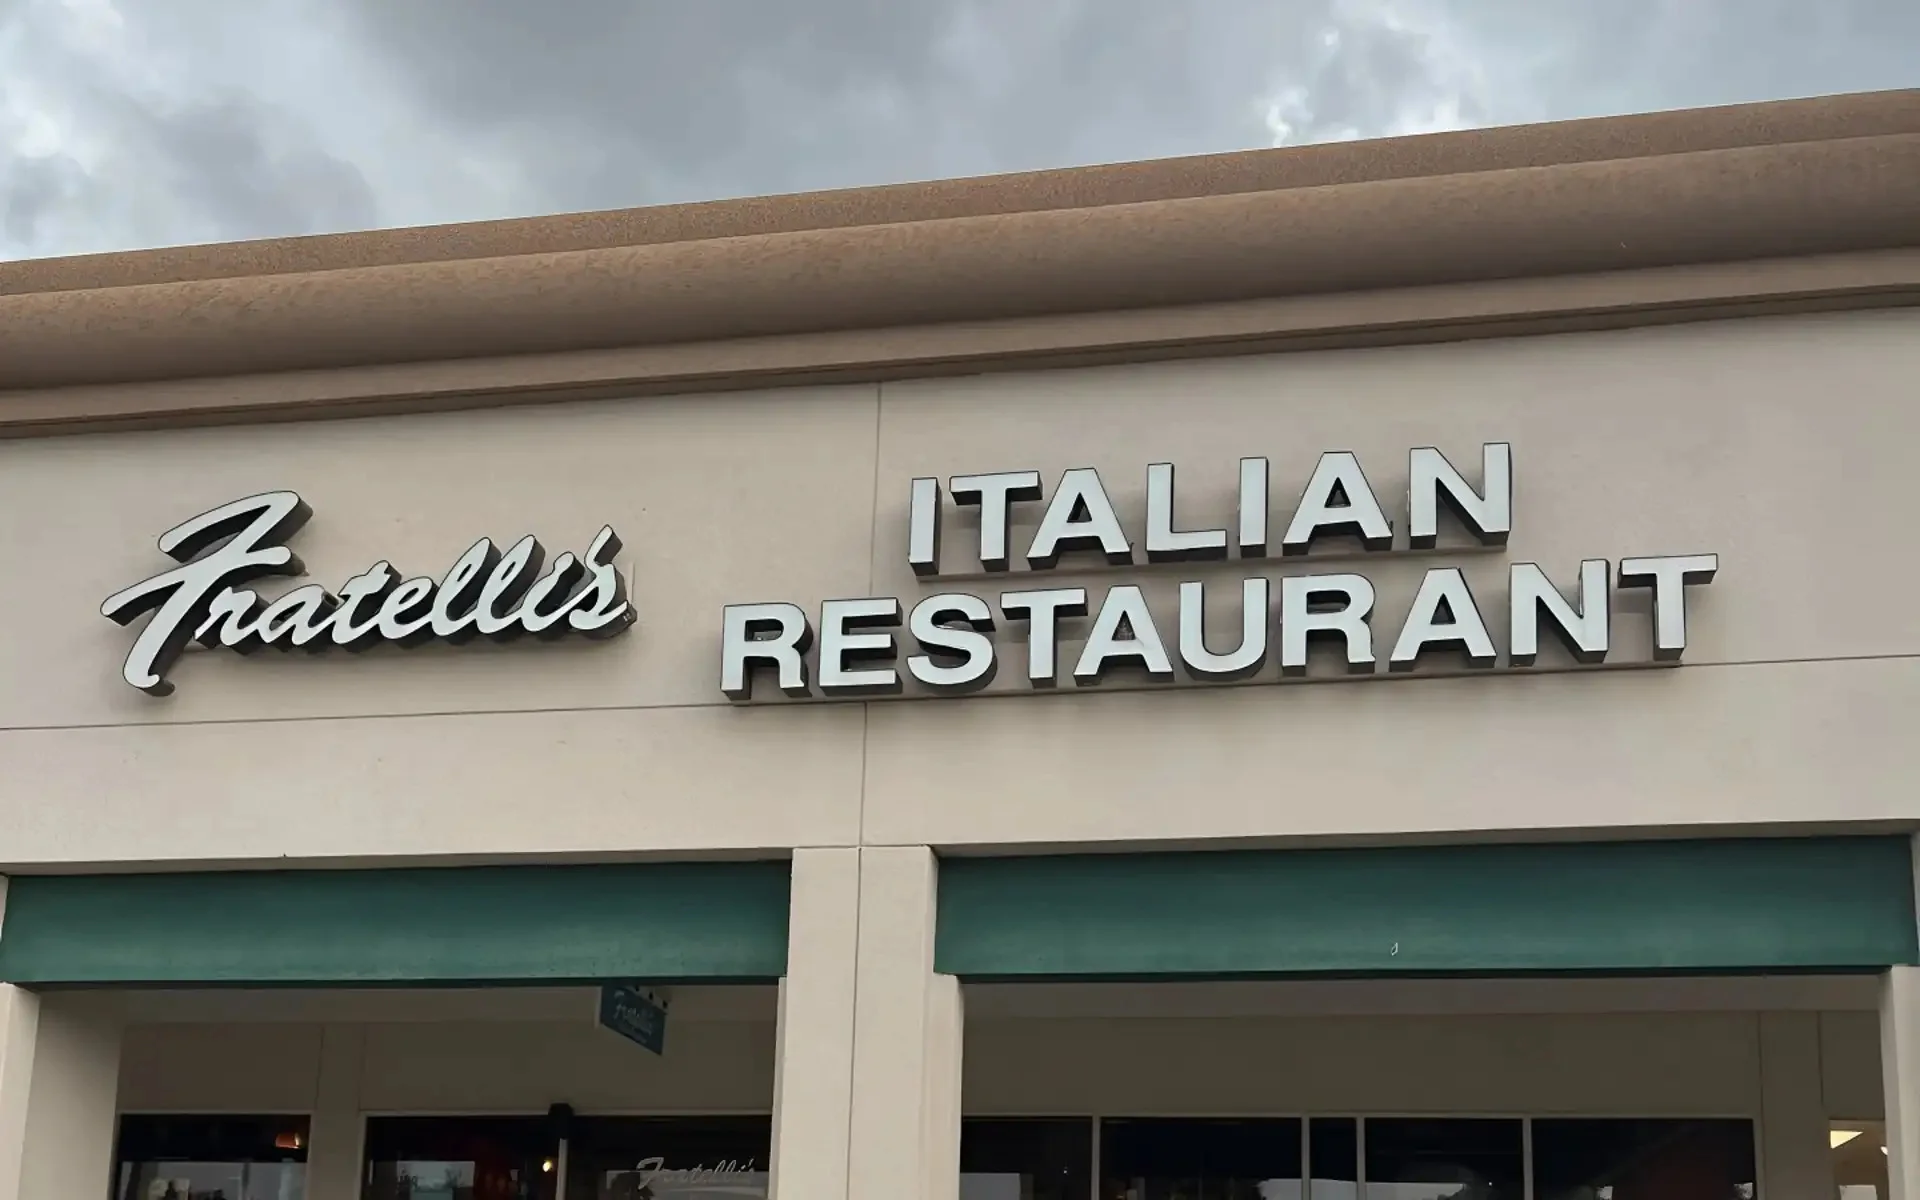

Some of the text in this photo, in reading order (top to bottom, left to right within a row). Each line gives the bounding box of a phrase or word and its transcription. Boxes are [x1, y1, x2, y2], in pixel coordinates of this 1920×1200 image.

[908, 442, 1512, 571] ITALIAN
[101, 490, 634, 692] Fratelli's
[720, 554, 1718, 698] RESTAURANT
